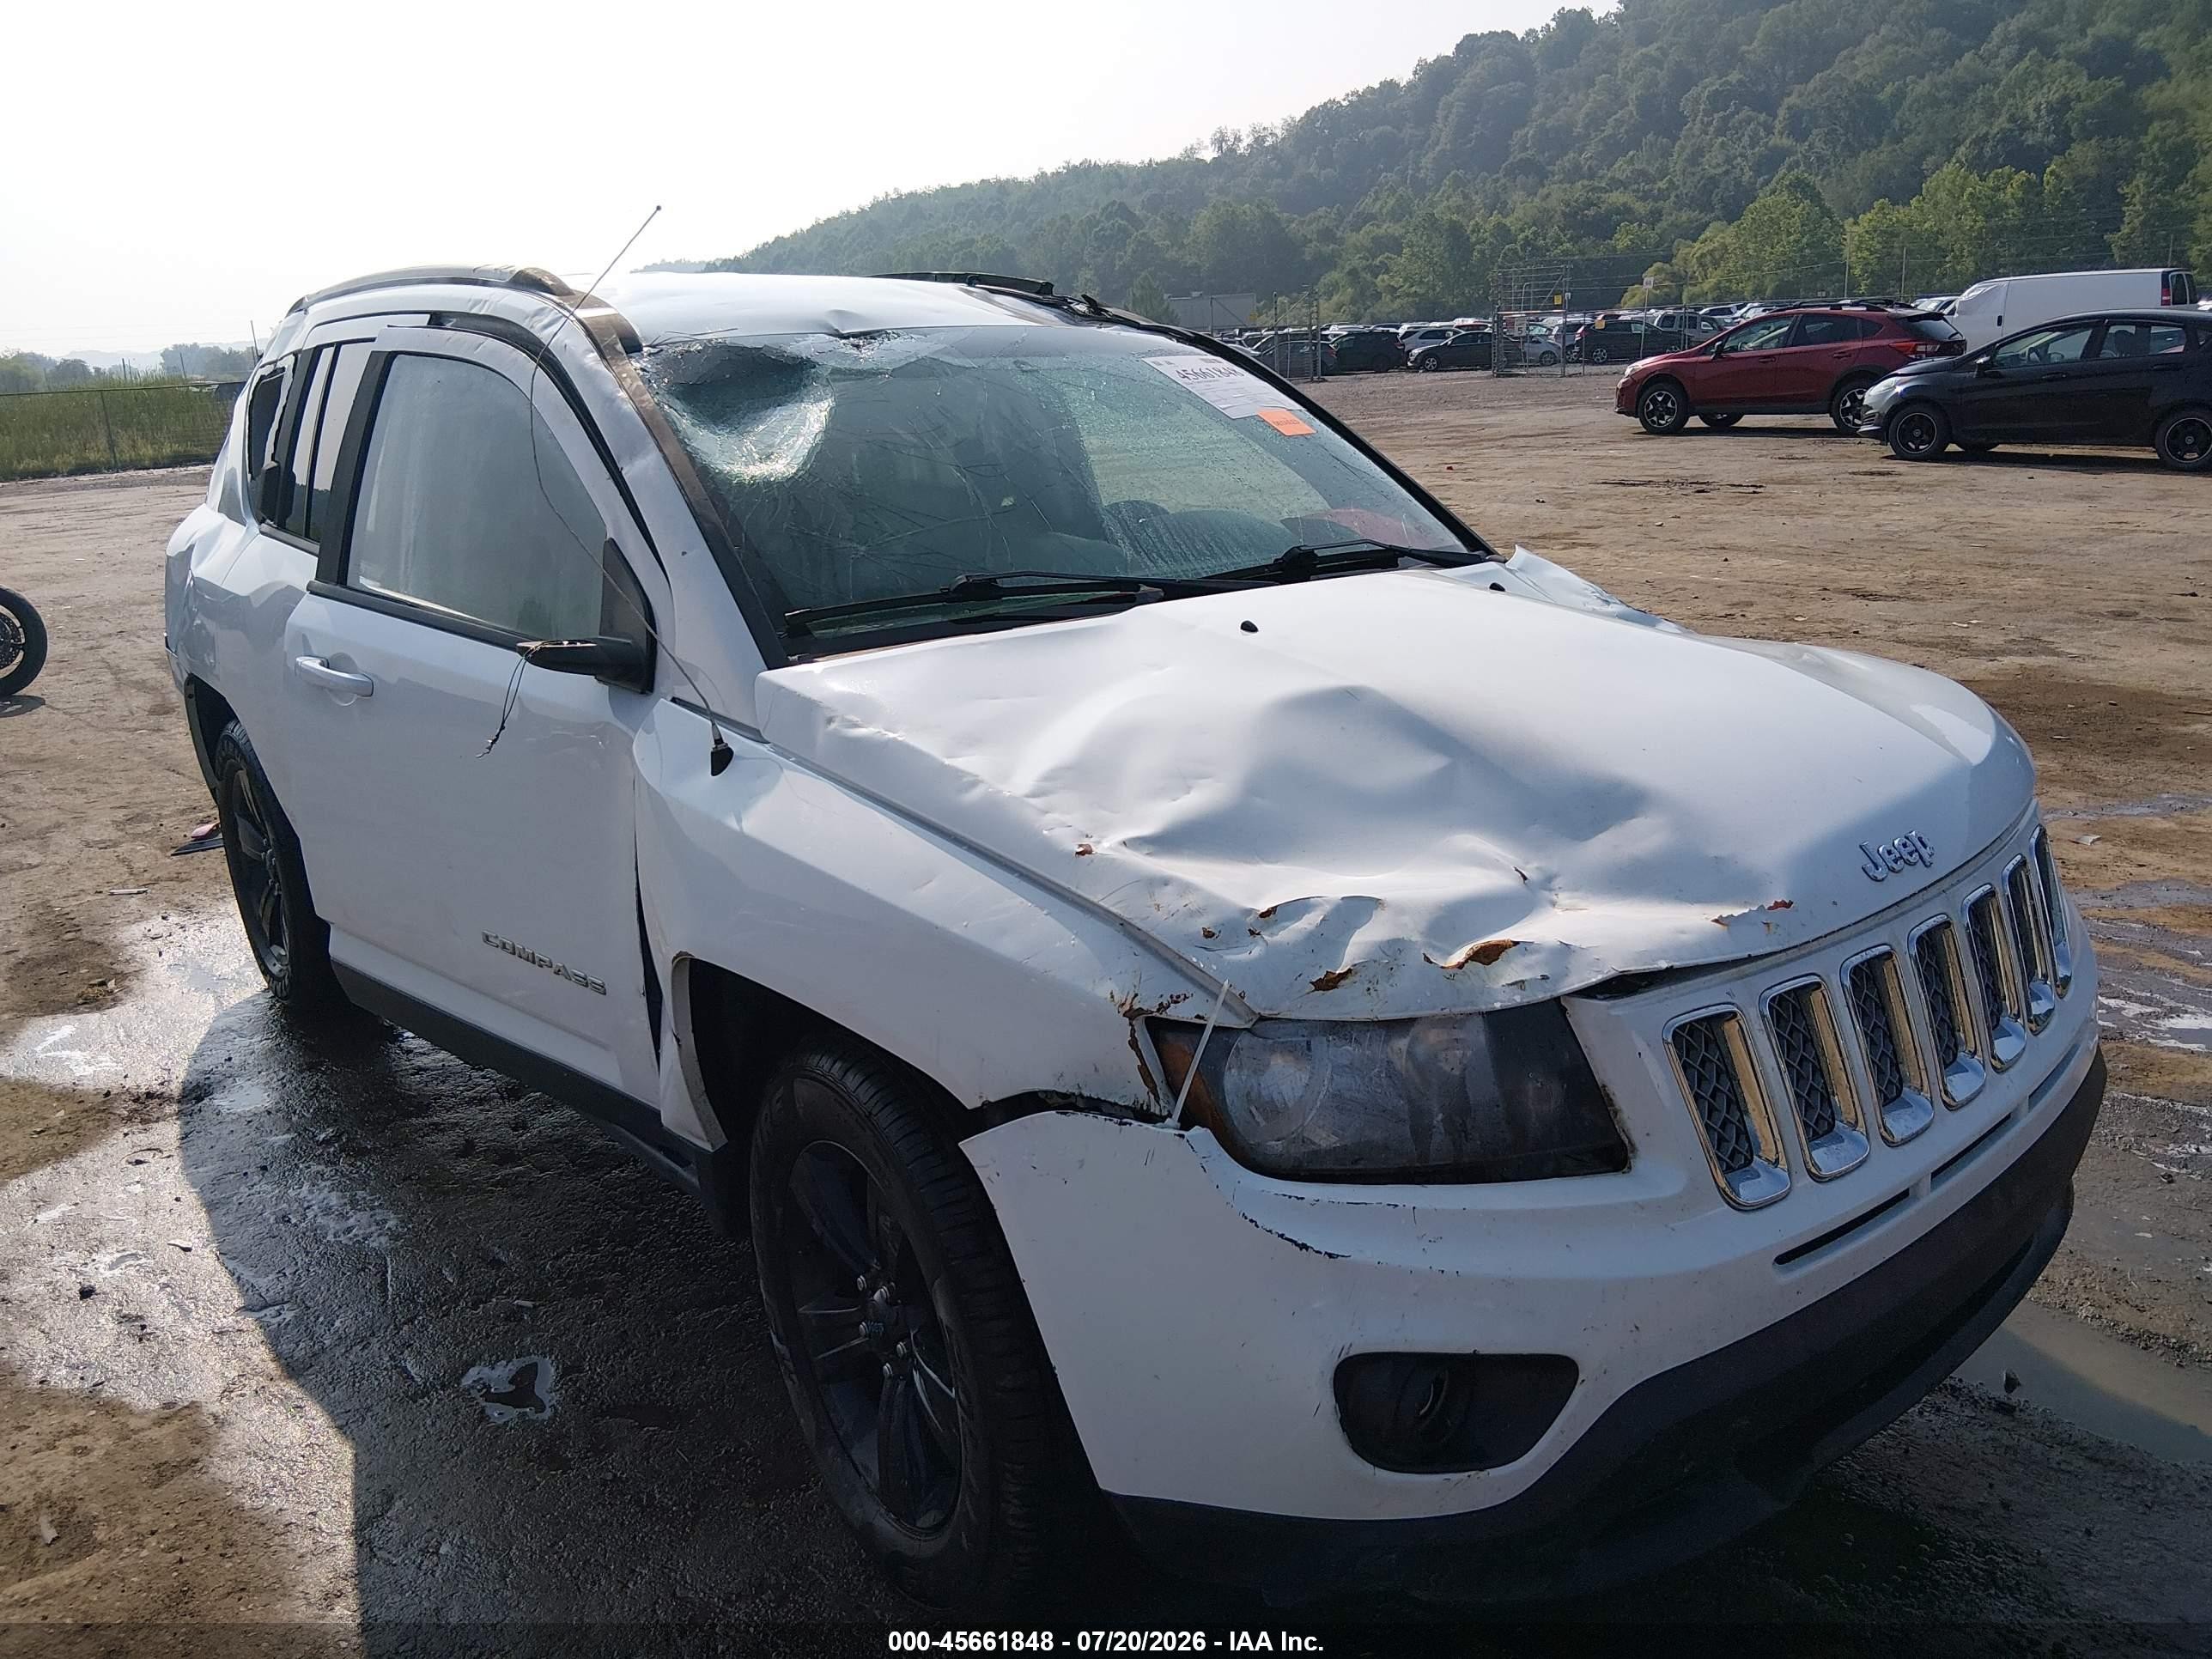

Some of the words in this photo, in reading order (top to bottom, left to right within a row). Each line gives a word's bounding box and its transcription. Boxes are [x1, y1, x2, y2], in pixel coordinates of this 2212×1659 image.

[1176, 367, 1244, 381] 45661848
[1859, 830, 1936, 882] Jeep
[482, 929, 607, 996] COMPASS
